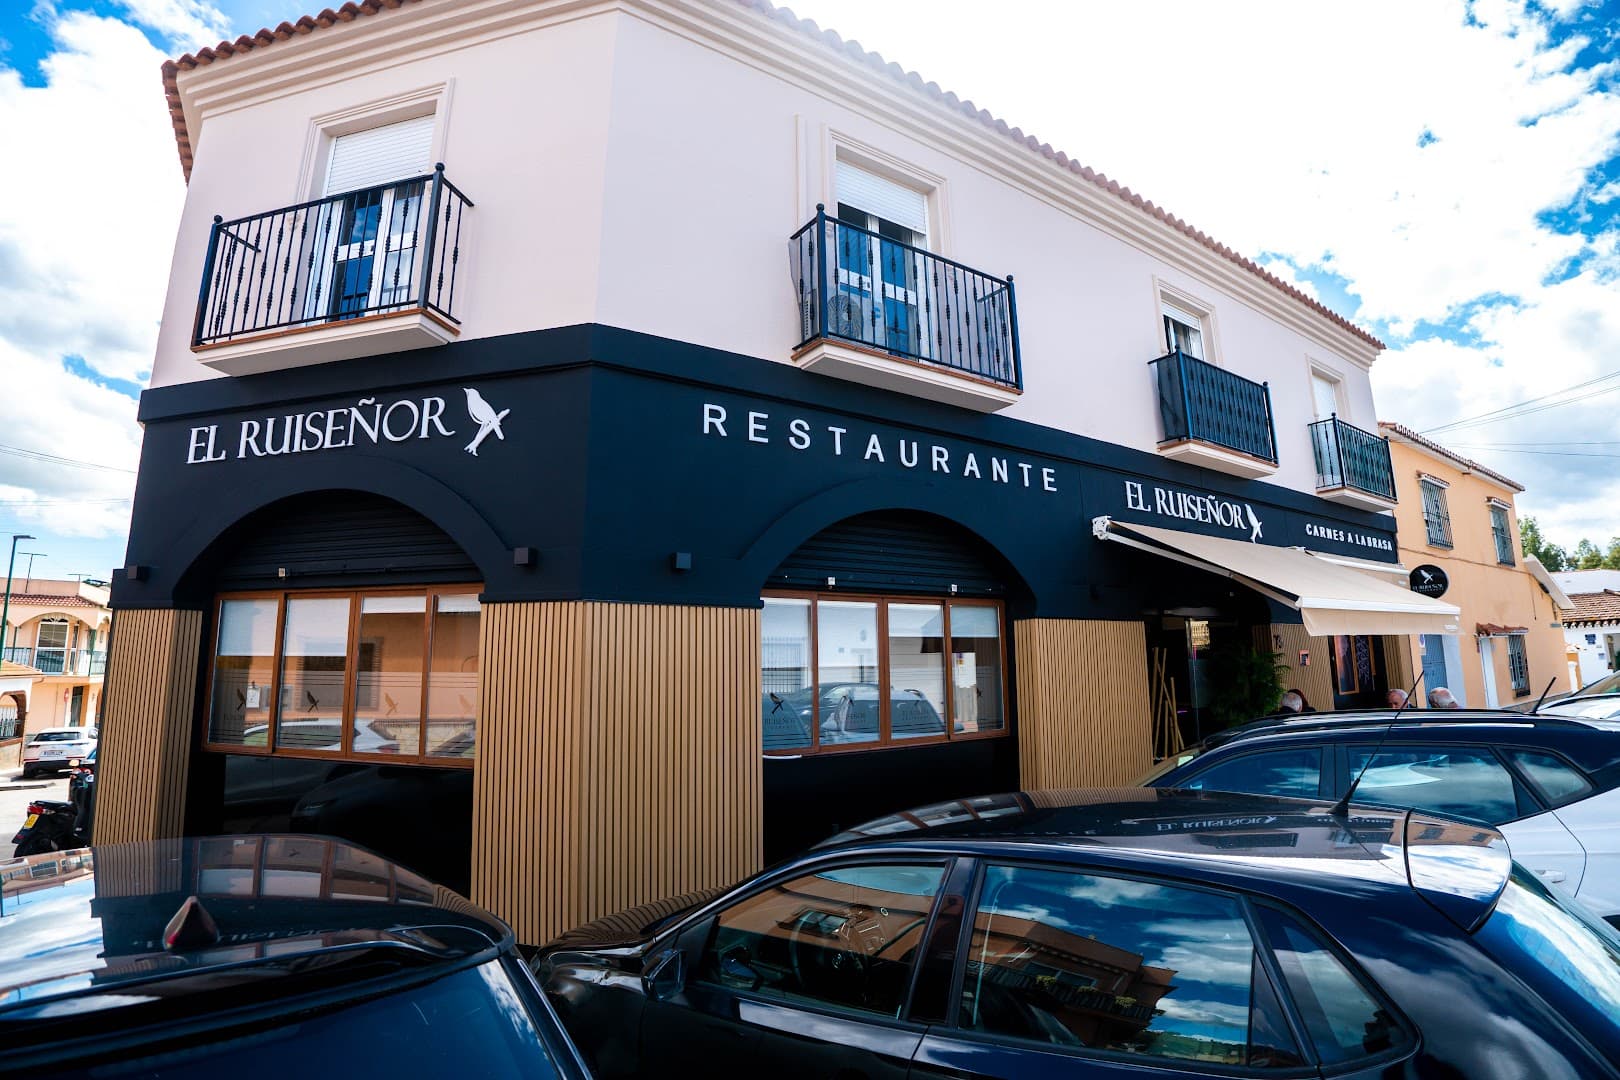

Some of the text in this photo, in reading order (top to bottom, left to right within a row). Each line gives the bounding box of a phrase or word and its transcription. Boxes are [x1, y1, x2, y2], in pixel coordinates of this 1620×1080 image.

[187, 397, 456, 464] EL RUISEÑOR
[703, 403, 1058, 492] RESTAURANTE
[1125, 481, 1248, 530] EL RUISEÑOR
[1306, 524, 1345, 542] CARNES
[1347, 532, 1353, 544] A
